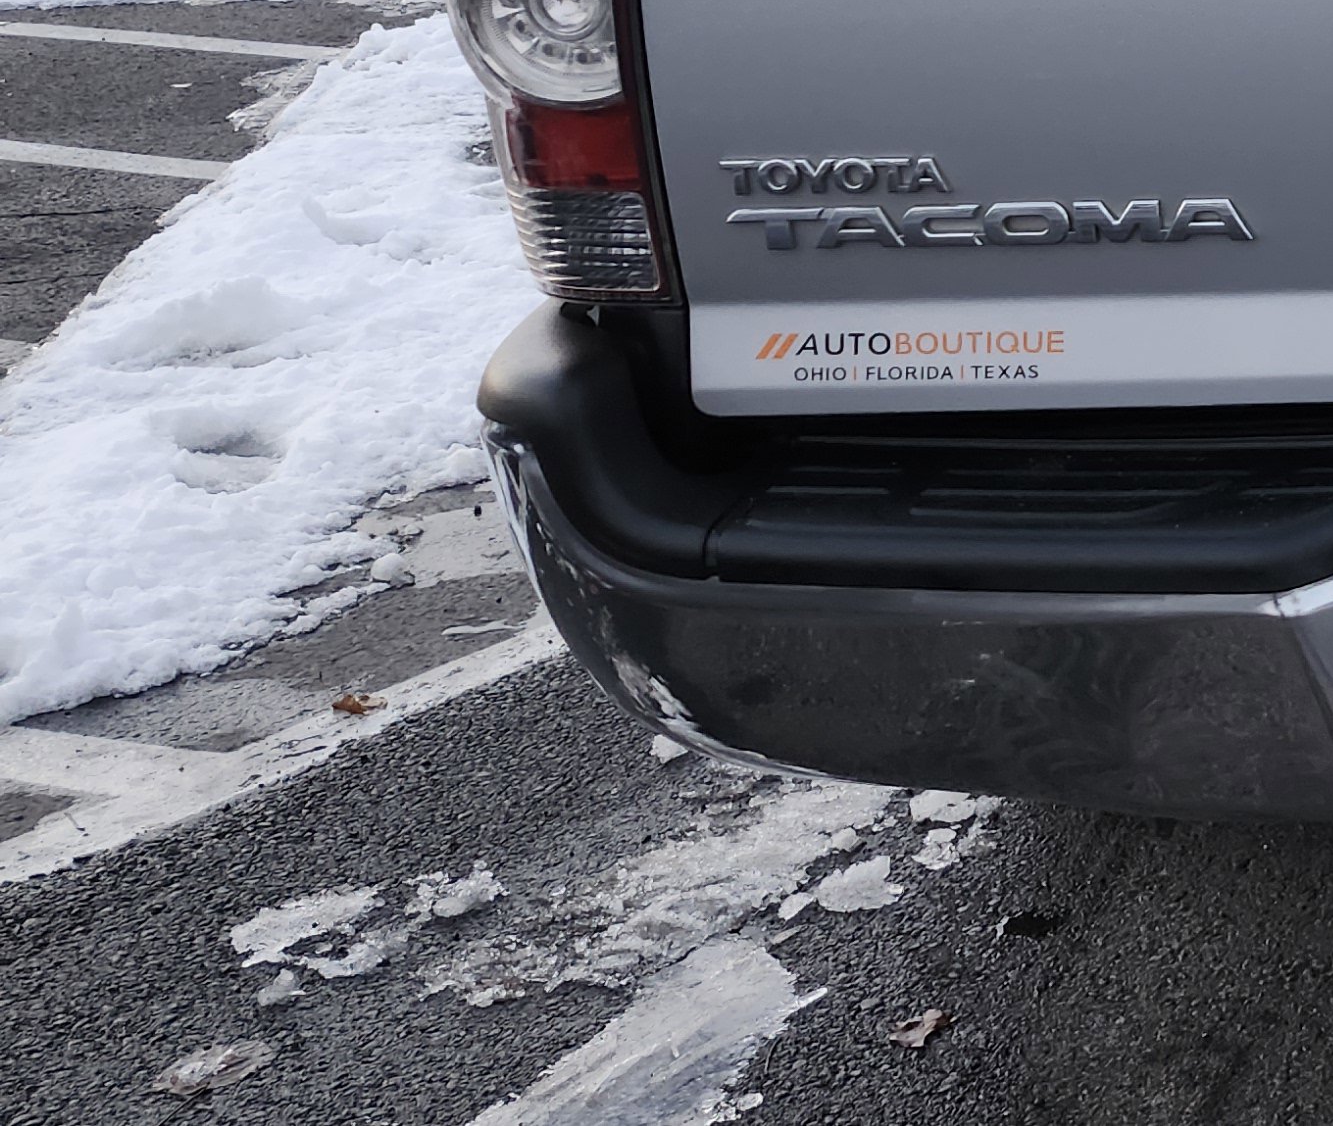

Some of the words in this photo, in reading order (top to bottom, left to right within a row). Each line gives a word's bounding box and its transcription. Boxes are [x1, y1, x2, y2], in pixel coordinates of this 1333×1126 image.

[719, 155, 952, 196] TOYOTA
[726, 196, 1256, 251] TACOMA
[795, 329, 1065, 356] AUTOBOUTIQUE
[793, 366, 848, 382] OHIO
[865, 365, 954, 381] FLORIDA
[970, 364, 1040, 380] TEXAS
